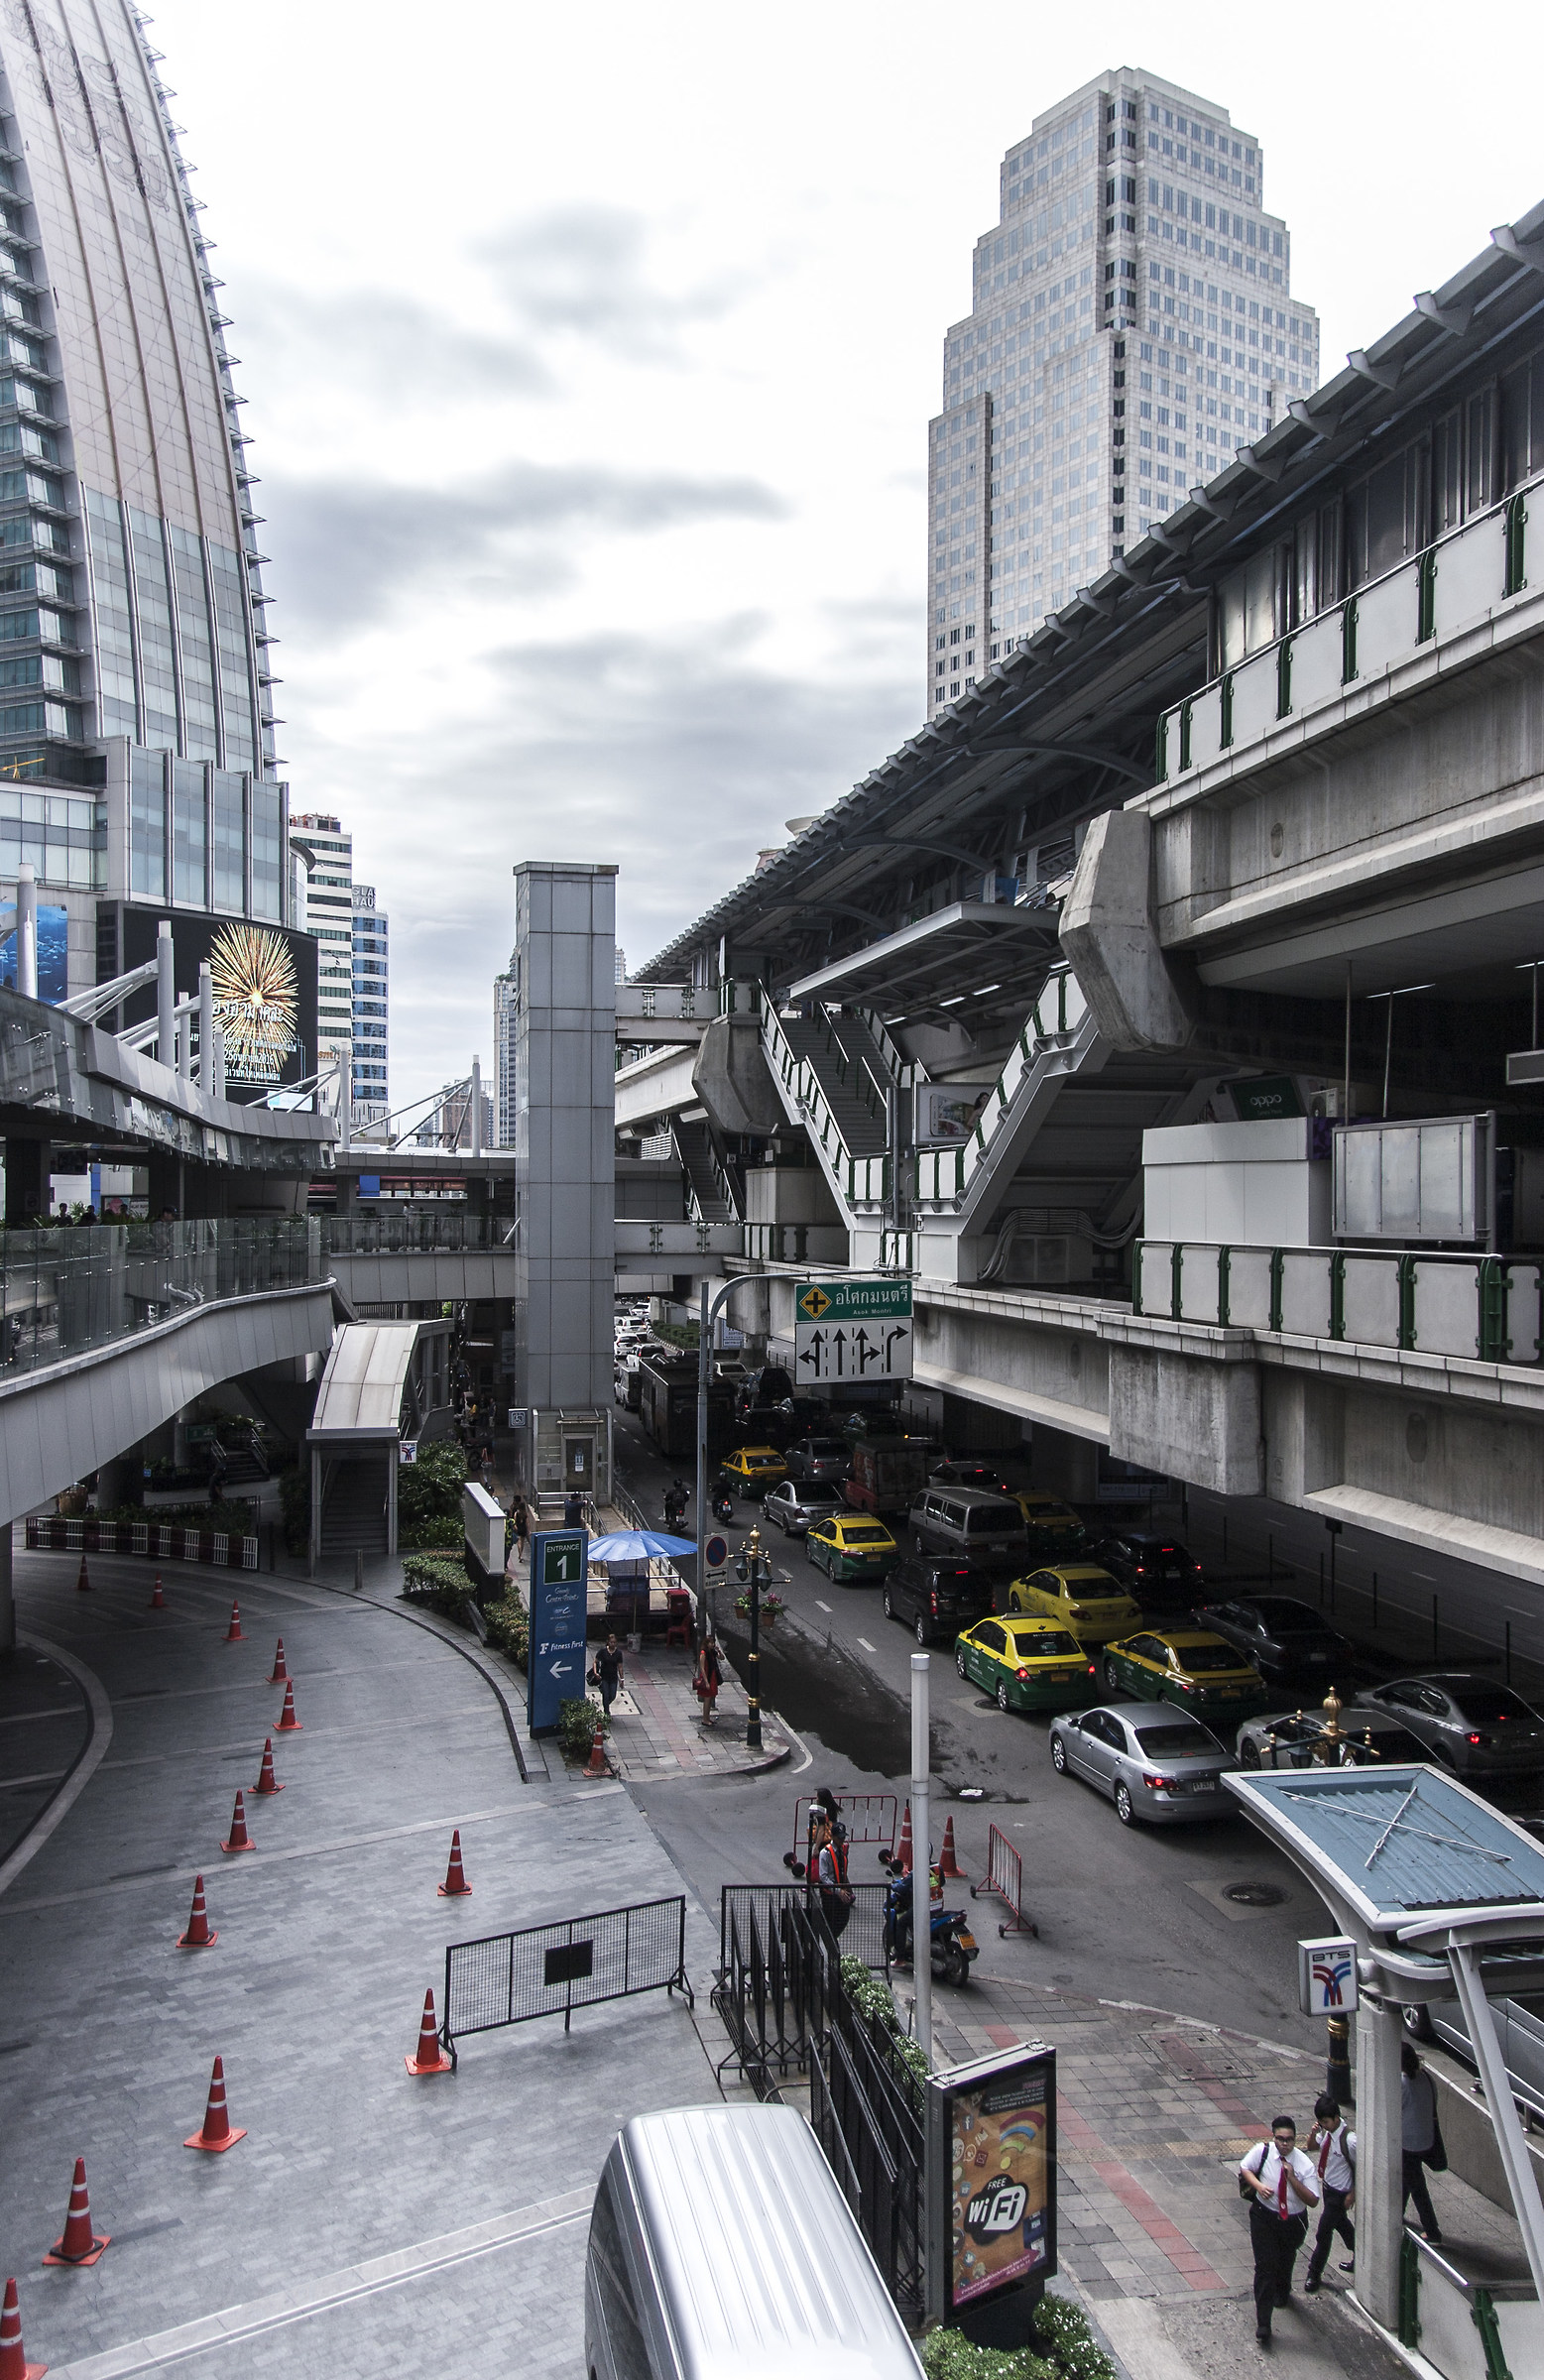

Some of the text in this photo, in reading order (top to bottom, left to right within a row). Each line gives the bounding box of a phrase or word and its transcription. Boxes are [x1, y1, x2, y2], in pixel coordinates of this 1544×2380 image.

[835, 1284, 908, 1305] อโศกมนตรี
[546, 1543, 580, 1553] ENTRANCE
[556, 1555, 567, 1580] 1
[550, 1640, 583, 1652] Fitness First
[1312, 1950, 1351, 1963] BTS
[987, 2177, 1008, 2191] FREE
